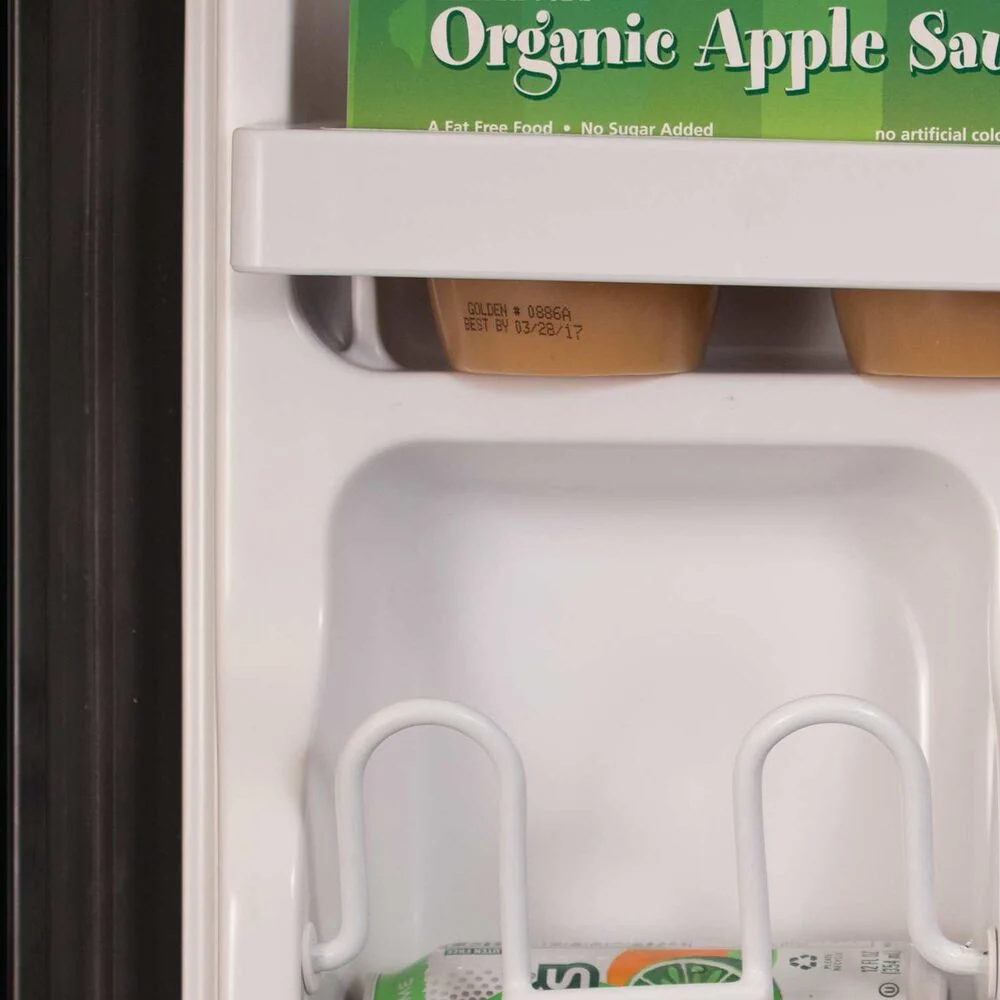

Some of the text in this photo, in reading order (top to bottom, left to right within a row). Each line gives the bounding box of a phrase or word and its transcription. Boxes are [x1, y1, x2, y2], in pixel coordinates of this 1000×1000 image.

[430, 6, 678, 98] Organic
[694, 6, 887, 95] Apple
[428, 120, 553, 134] A Fat Free Food
[581, 121, 714, 136] No Sugar Added
[875, 128, 896, 141] no
[901, 126, 967, 142] artificial
[467, 301, 507, 316] GOLDEN
[463, 317, 583, 340] BEST BY 03/28/17
